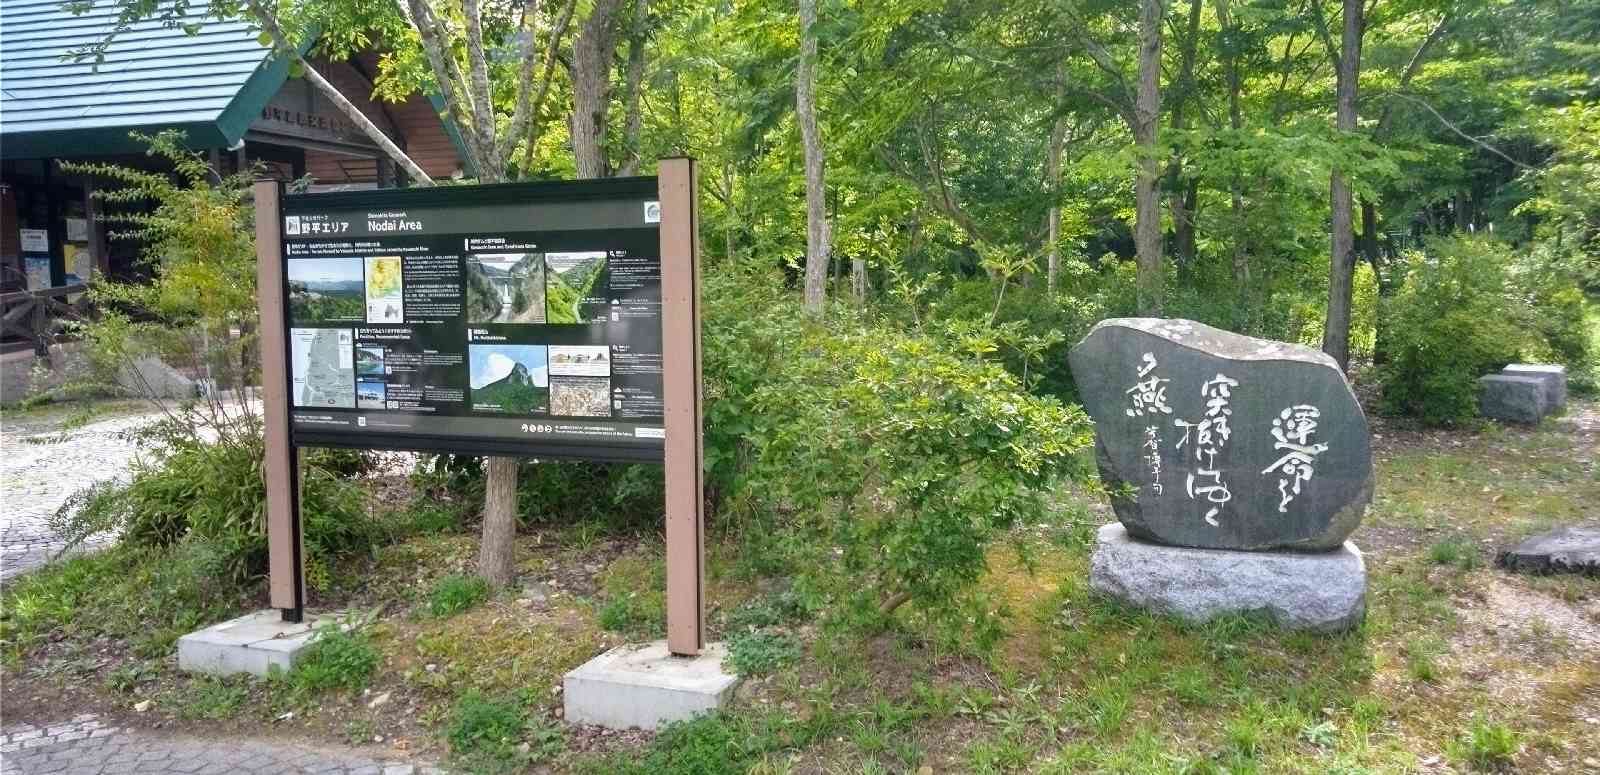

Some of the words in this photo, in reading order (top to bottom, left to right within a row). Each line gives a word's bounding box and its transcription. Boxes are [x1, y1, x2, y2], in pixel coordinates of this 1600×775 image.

[301, 222, 350, 234] 野平エリア
[367, 220, 397, 232] Nodai
[398, 219, 423, 231] Area
